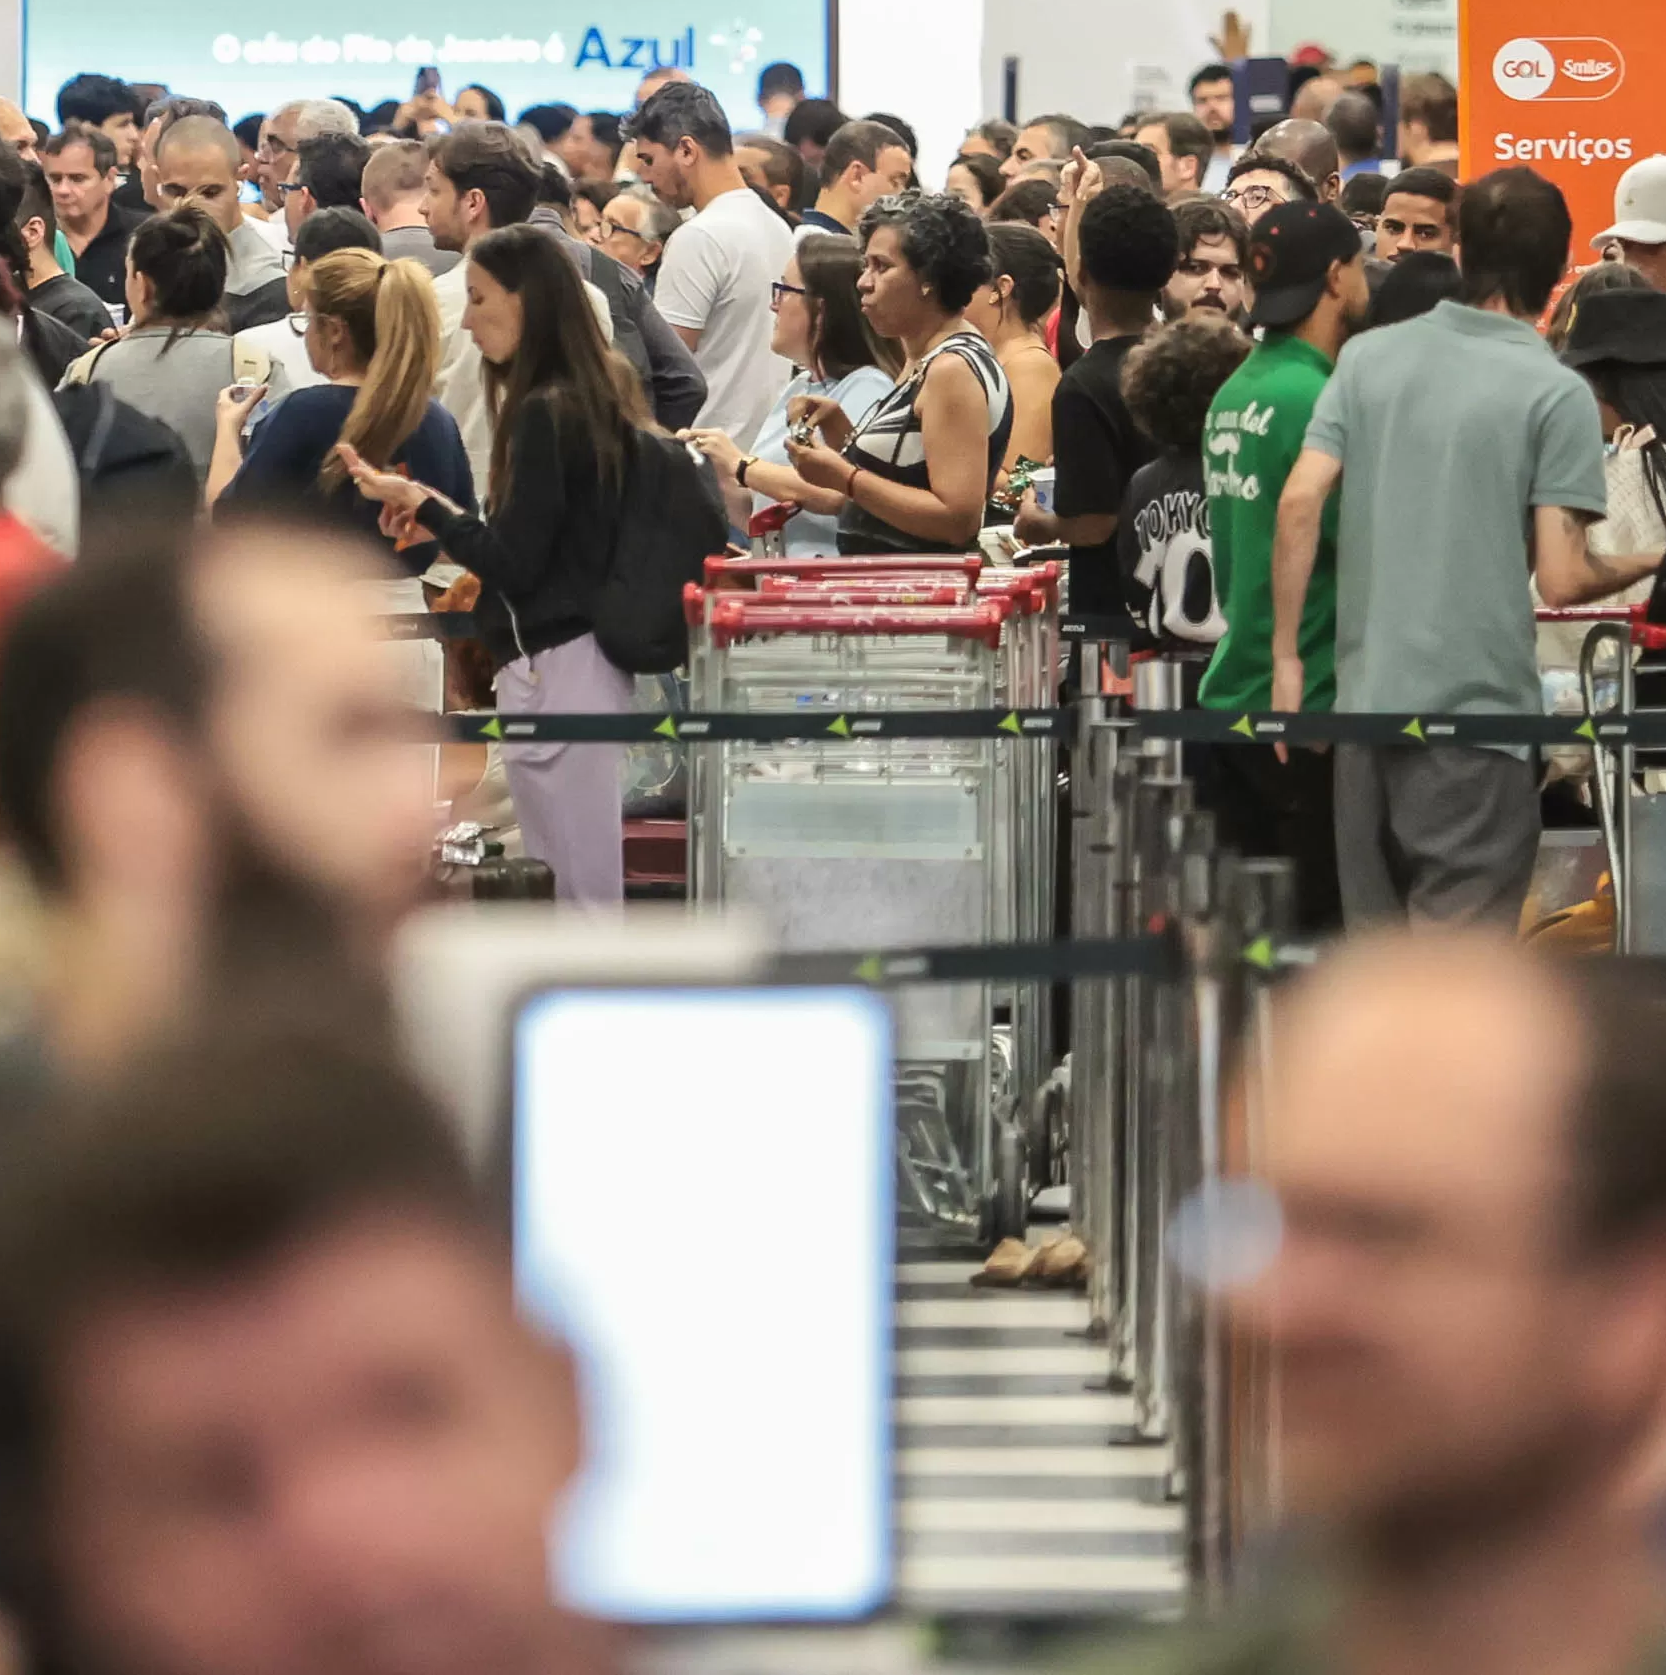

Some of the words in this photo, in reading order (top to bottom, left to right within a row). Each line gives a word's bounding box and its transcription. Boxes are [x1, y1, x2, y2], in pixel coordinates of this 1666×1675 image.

[574, 26, 695, 68] Azul
[1502, 60, 1547, 78] GOL
[1562, 59, 1614, 78] Smiles
[1494, 131, 1632, 165] Serviços
